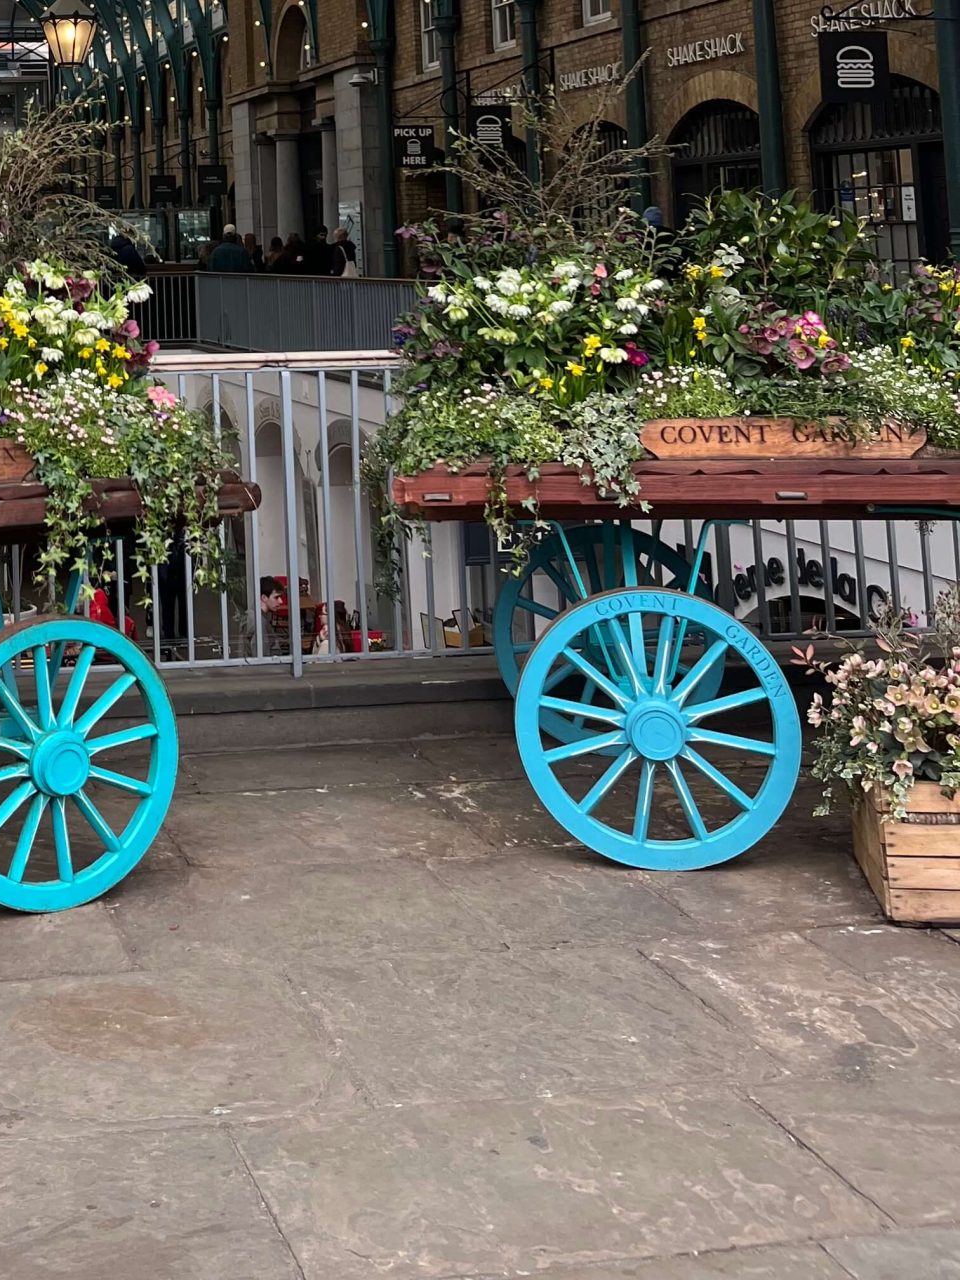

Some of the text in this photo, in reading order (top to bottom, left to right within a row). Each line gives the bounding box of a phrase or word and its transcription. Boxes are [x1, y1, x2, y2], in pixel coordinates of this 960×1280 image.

[394, 128, 432, 137] PICK UP
[403, 156, 426, 165] HERE
[660, 420, 903, 444] COVENT GARN
[595, 595, 787, 699] COVENT GARDEN
